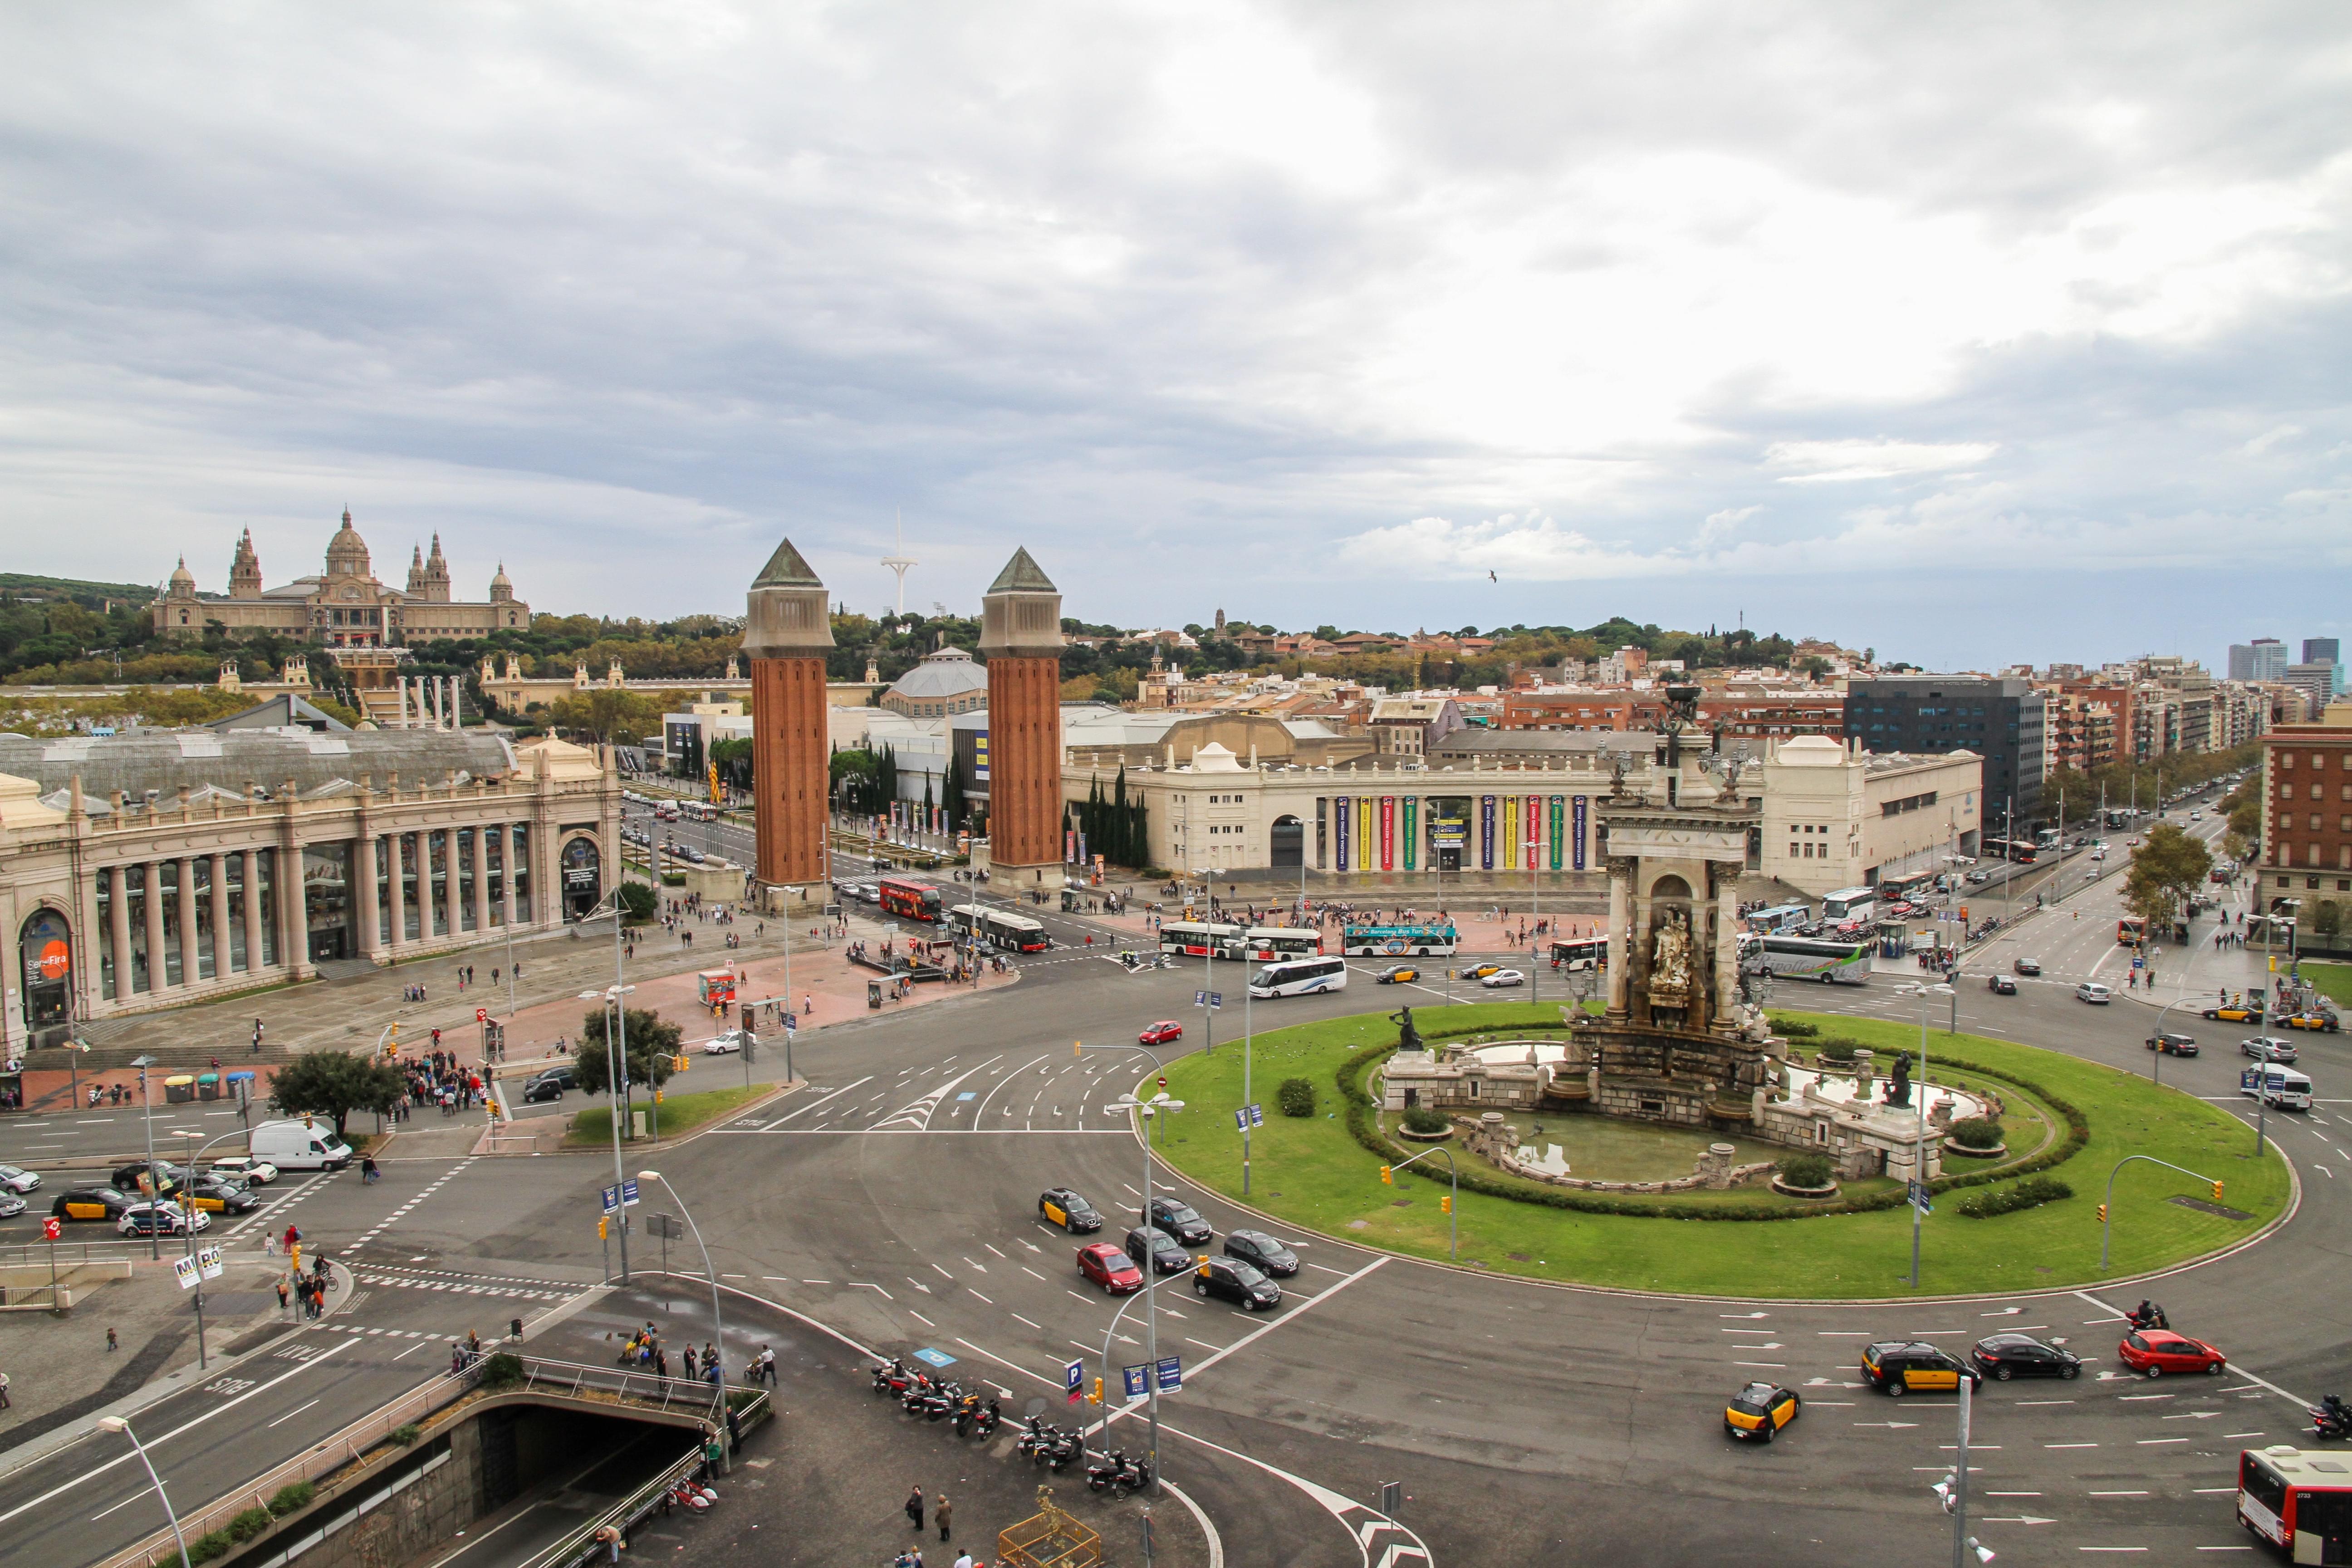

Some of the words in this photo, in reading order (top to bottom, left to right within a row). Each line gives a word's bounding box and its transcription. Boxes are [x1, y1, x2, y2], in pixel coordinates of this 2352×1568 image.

[28, 955, 66, 970] SeriFira
[273, 1344, 325, 1361] TAXI
[1070, 1367, 1078, 1383] P
[204, 1377, 256, 1395] BUS
[2269, 1476, 2279, 1487] 2733
